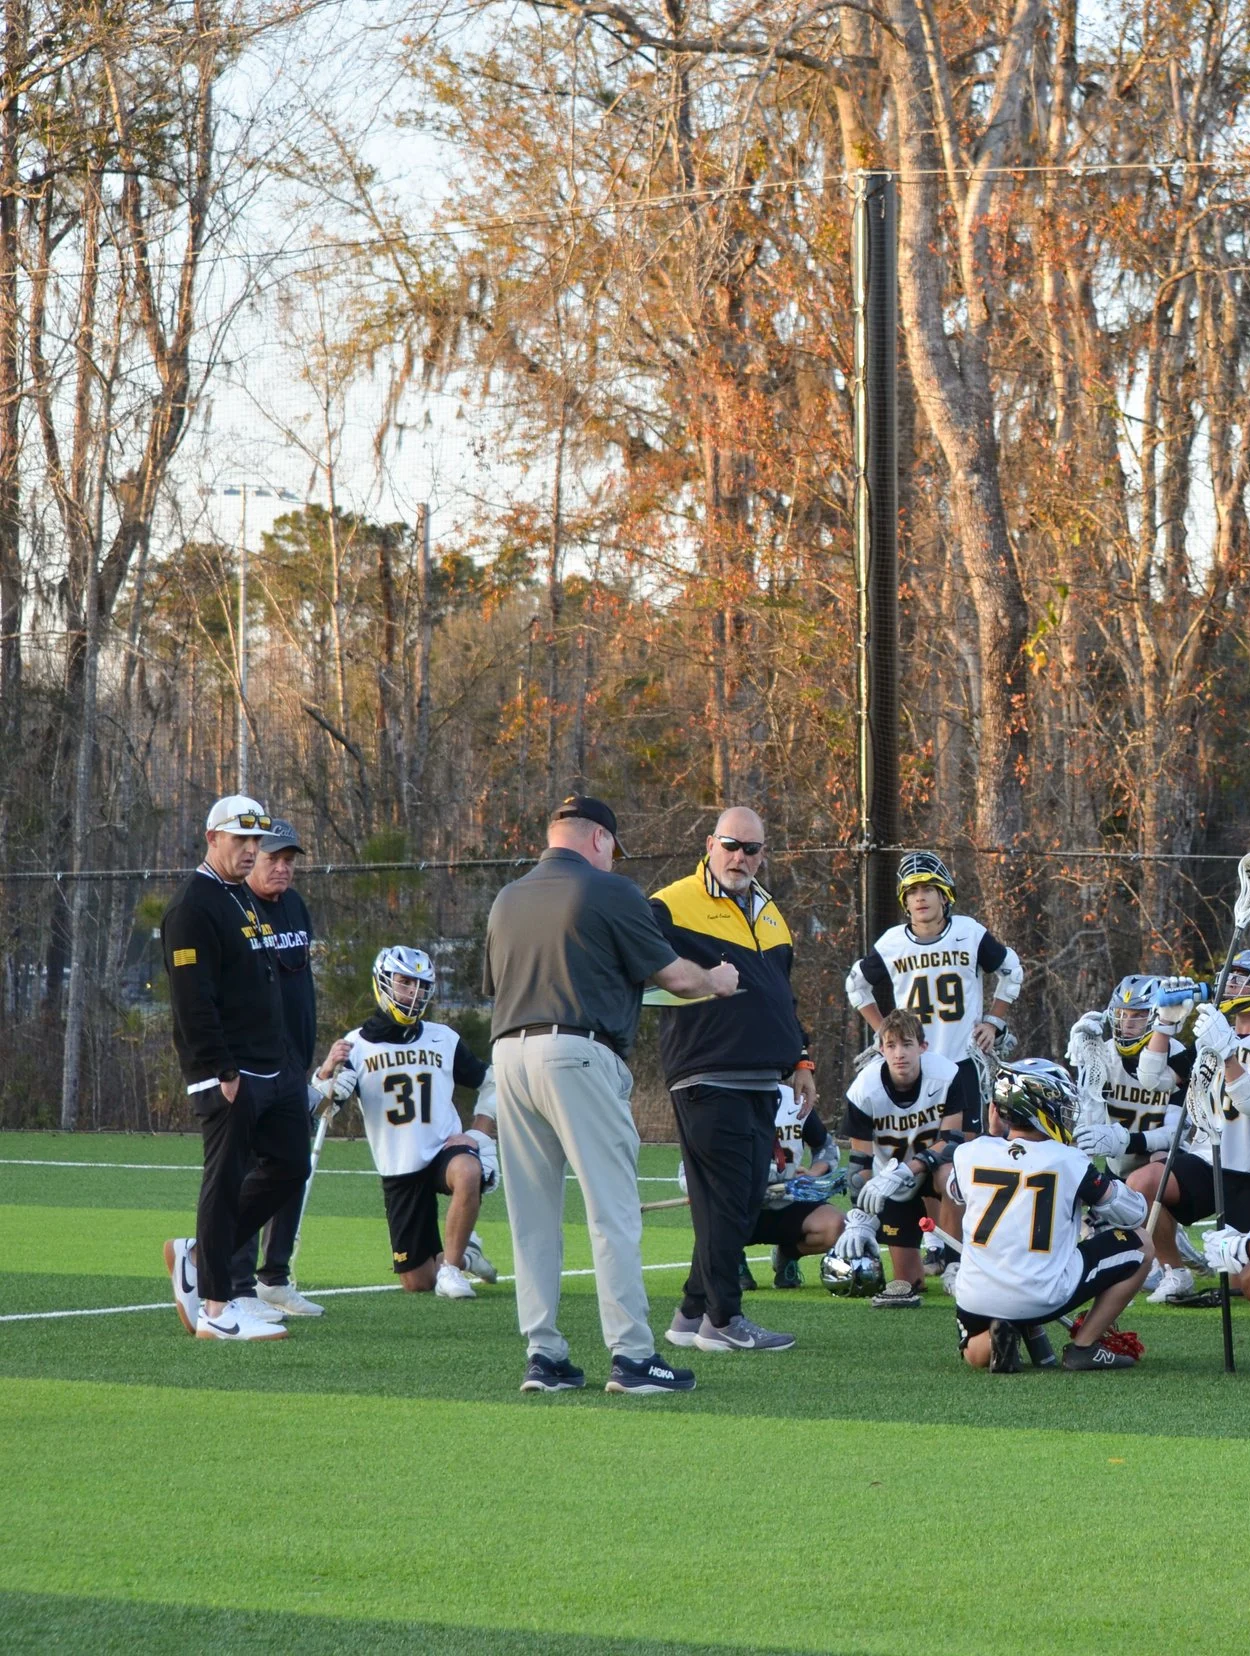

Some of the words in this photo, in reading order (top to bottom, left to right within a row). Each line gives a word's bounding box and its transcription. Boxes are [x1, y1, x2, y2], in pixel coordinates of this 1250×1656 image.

[894, 950, 971, 974] WILDCATS
[907, 972, 966, 1025] 49
[364, 1049, 443, 1073] WILDCATS
[382, 1072, 432, 1126] 31
[872, 1103, 947, 1132] WILDCATS
[971, 1166, 1059, 1254] 71
[648, 1366, 674, 1380] HOKA
